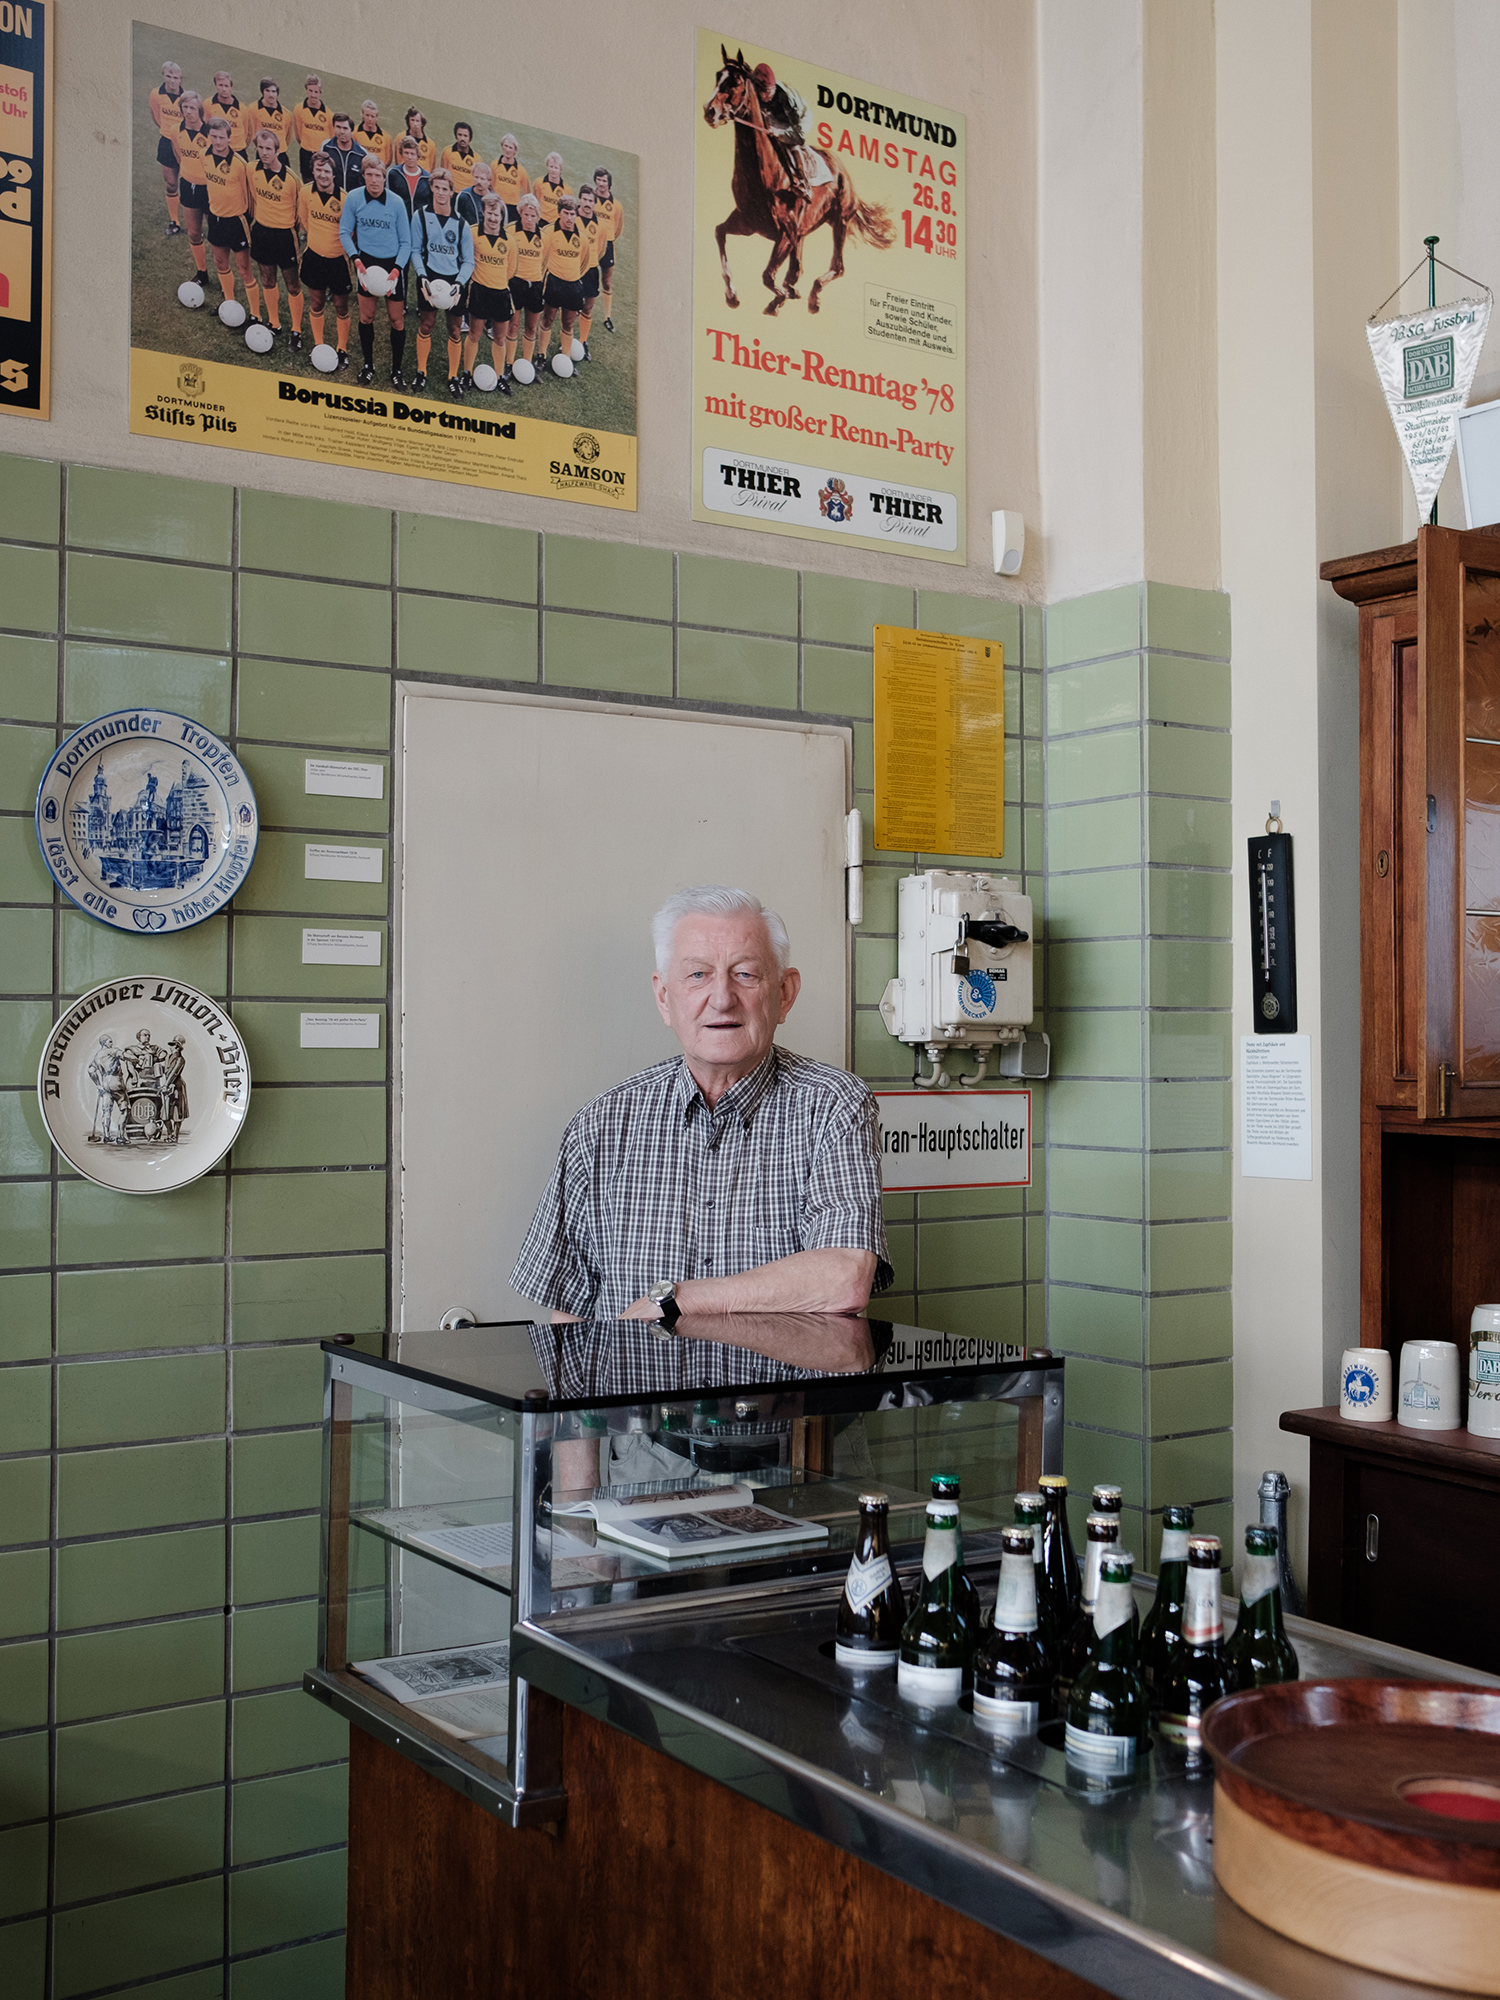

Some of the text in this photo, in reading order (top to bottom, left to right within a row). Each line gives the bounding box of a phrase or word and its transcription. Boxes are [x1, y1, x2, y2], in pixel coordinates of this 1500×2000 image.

[2, 101, 28, 118] Uhr
[162, 108, 181, 117] SAMSO
[816, 84, 957, 149] DORTMUND
[816, 121, 957, 187] SAMSTAG
[912, 182, 957, 217] 26.8.
[310, 210, 340, 224] SAMSON
[360, 217, 391, 230] SAMSON
[901, 208, 957, 255] 14 30
[429, 243, 455, 255] SAMSON
[479, 253, 504, 266] SAMSON
[934, 246, 957, 260] UHR
[869, 297, 953, 327] für Frauen und Kinder,
[886, 292, 935, 312] Freier Eintritt
[875, 318, 947, 343] Auszubildende und
[884, 312, 939, 332] sowie Schüler,
[867, 325, 955, 355] Studenten mit Ausweis.
[1408, 343, 1448, 358] DORTMUNDER
[705, 327, 918, 411] Thier-Renntag
[1408, 353, 1449, 384] DAB
[145, 404, 237, 433] Stifts Pils
[157, 394, 226, 413] DORTMUNDER
[278, 380, 516, 440] Borussia Dortmund
[324, 412, 388, 428] Lizenzspieler-Aufgebot
[407, 426, 453, 439] Bundesligasaison
[454, 434, 476, 443] 1977/78
[704, 392, 955, 467] mit großer Renn-Party
[549, 460, 626, 485] SAMSON
[720, 464, 802, 499] THIER
[732, 458, 790, 476] DORTMUNDER
[869, 492, 943, 525] THIER
[880, 487, 933, 504] DORTMUNDER
[55, 713, 163, 779] Dortmunder
[179, 722, 240, 788] Tropfen
[46, 836, 80, 887] lässt
[82, 890, 118, 919] alle
[172, 891, 221, 925] höher
[44, 983, 145, 1101] Dortmunder
[149, 982, 224, 1036] Union
[880, 1121, 1025, 1160] ran-Hauptschalter
